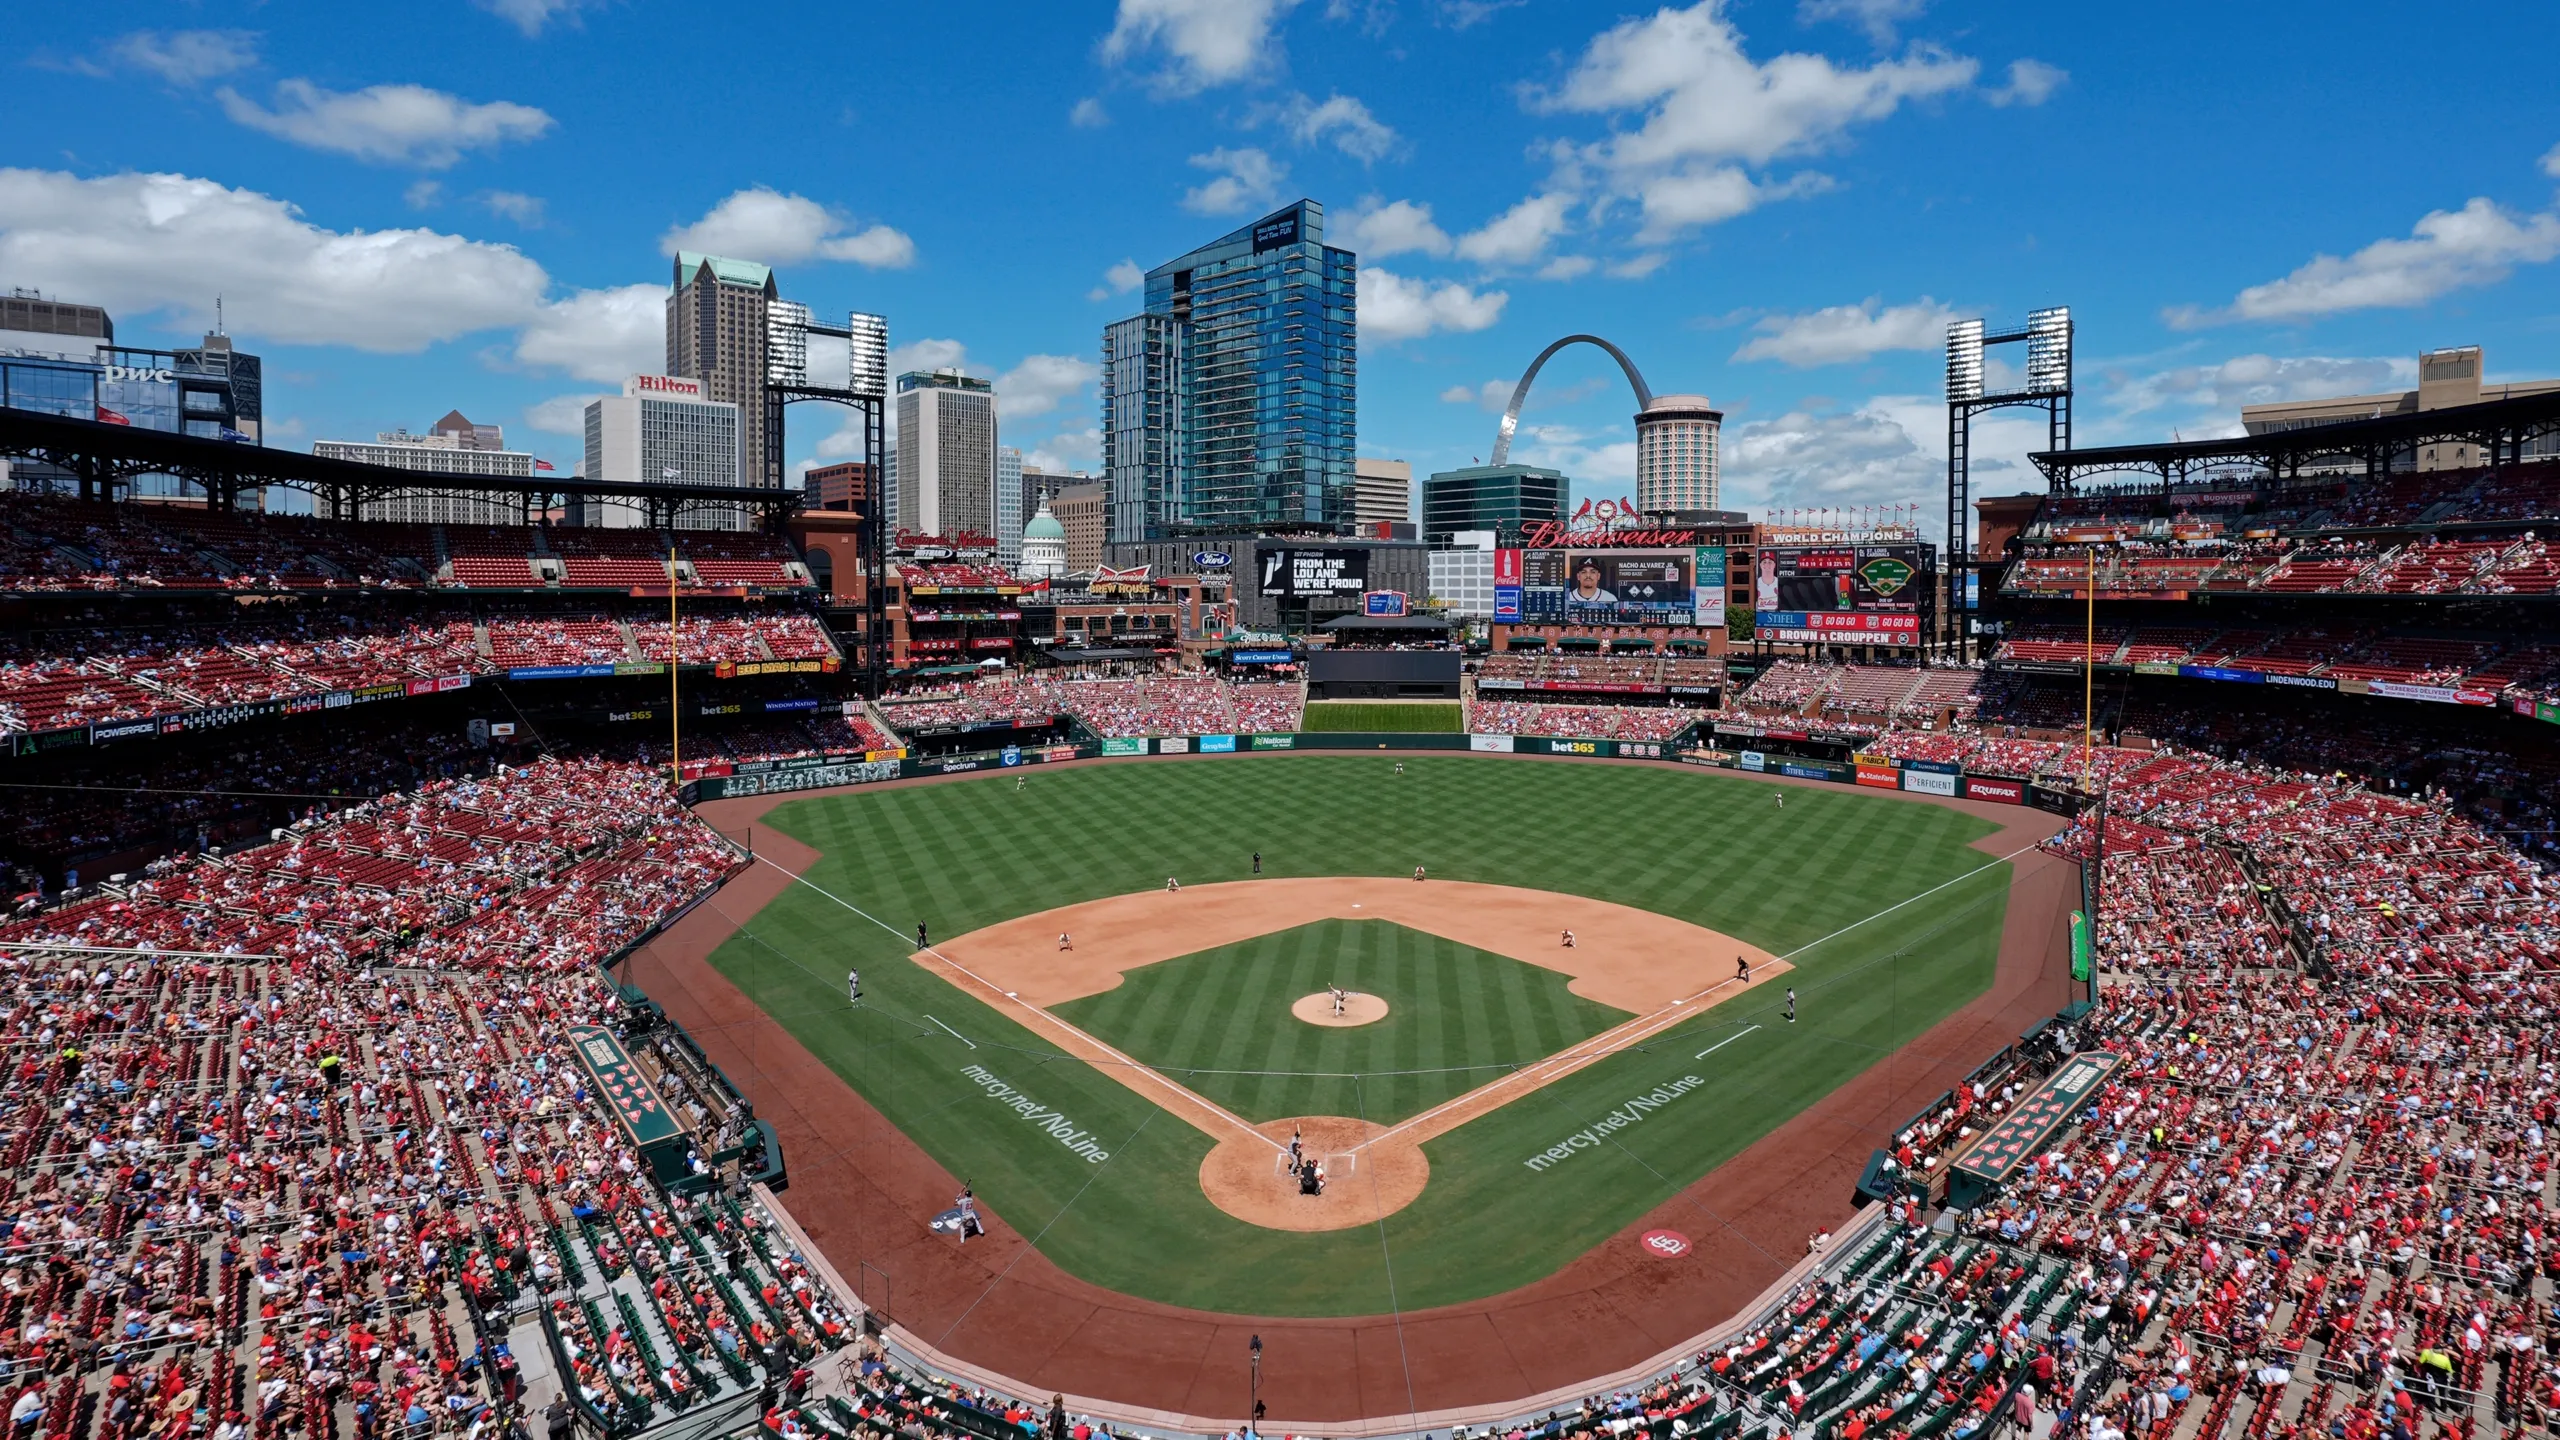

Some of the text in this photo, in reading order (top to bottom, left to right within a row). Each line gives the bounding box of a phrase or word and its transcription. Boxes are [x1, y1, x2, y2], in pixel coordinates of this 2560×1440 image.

[1280, 227, 1292, 236] FUN
[103, 366, 174, 385] pwc
[639, 376, 699, 394] Hilton
[2203, 494, 2252, 502] BUDWEISER
[895, 528, 997, 549] Cardinals Nation
[1521, 520, 1695, 549] Budweiser
[1773, 531, 1903, 543] WORLD CHAMPIONS
[1203, 553, 1224, 565] Ford
[1293, 559, 1345, 568] FROM THE
[1092, 570, 1146, 583] Budweiser
[1197, 574, 1231, 582] Community
[1293, 568, 1338, 579] LOU AND
[1293, 579, 1363, 589] WE'RE PROUD
[1495, 576, 1519, 585] Coca-Cola
[1090, 584, 1150, 594] BREW HOUSE
[1767, 614, 1796, 624] STIFEL
[1826, 615, 1914, 628] GO GO GO GO GO GO
[1779, 630, 1889, 643] BROWN & CROUPPEN
[761, 662, 789, 674] MAC
[790, 661, 821, 672] LAND
[413, 680, 434, 694] Coca-Cola
[441, 678, 461, 689] KMOX
[2265, 674, 2336, 689] LINDENWOOD.EDU
[1642, 685, 1661, 693] Coca-Cola
[1682, 686, 1710, 694] PHORM
[2384, 685, 2450, 696] DIERBERGS DELIVERS
[2458, 693, 2493, 704] Dierbergs
[701, 705, 741, 715] bet365
[765, 700, 818, 710] WINDOW NATION
[169, 715, 180, 723] ATL
[609, 711, 652, 722] bet365
[95, 723, 154, 740] POWERADE
[169, 724, 180, 732] STL
[1717, 725, 1750, 733] Schnucks
[1755, 729, 1766, 737] UP
[1262, 736, 1292, 745] National
[1551, 741, 1595, 753] bet365
[874, 751, 899, 759] DOBBS
[788, 759, 805, 768] Central
[806, 758, 823, 766] Bank
[1698, 759, 1720, 767] STADIUM
[1862, 756, 1902, 767] FABICK CAT
[1917, 763, 1940, 771] SUMNER
[943, 762, 976, 773] Spectrum
[1785, 767, 1805, 777] STIFEL
[1866, 772, 1897, 783] StateFarm
[1906, 775, 1952, 791] PERFICIENT
[1970, 784, 2017, 798] EQUIFAX
[959, 1064, 1109, 1164] mercy.net/NoLine
[1523, 1075, 1705, 1172] mercy.net/NoLine
